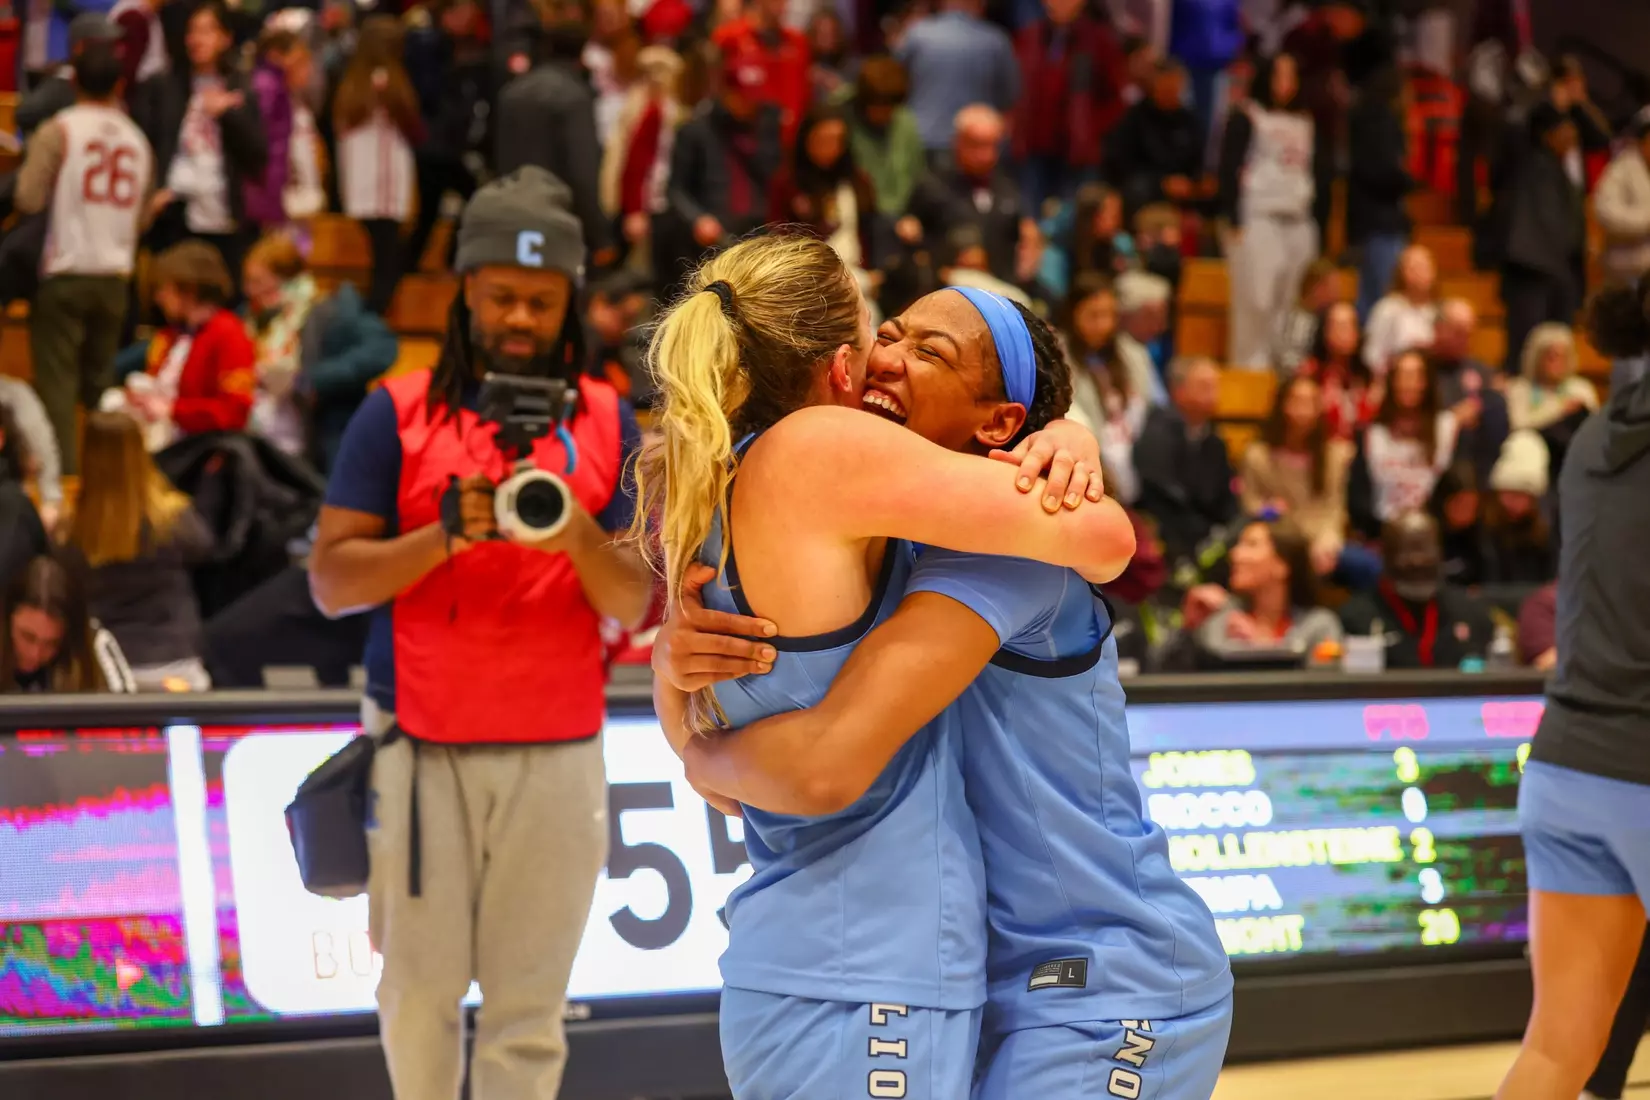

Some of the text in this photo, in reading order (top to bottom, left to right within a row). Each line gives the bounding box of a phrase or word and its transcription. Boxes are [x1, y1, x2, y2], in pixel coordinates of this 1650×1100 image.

[82, 140, 139, 209] 26
[516, 230, 545, 267] C
[1410, 827, 1437, 863] 2
[1068, 967, 1075, 978] L
